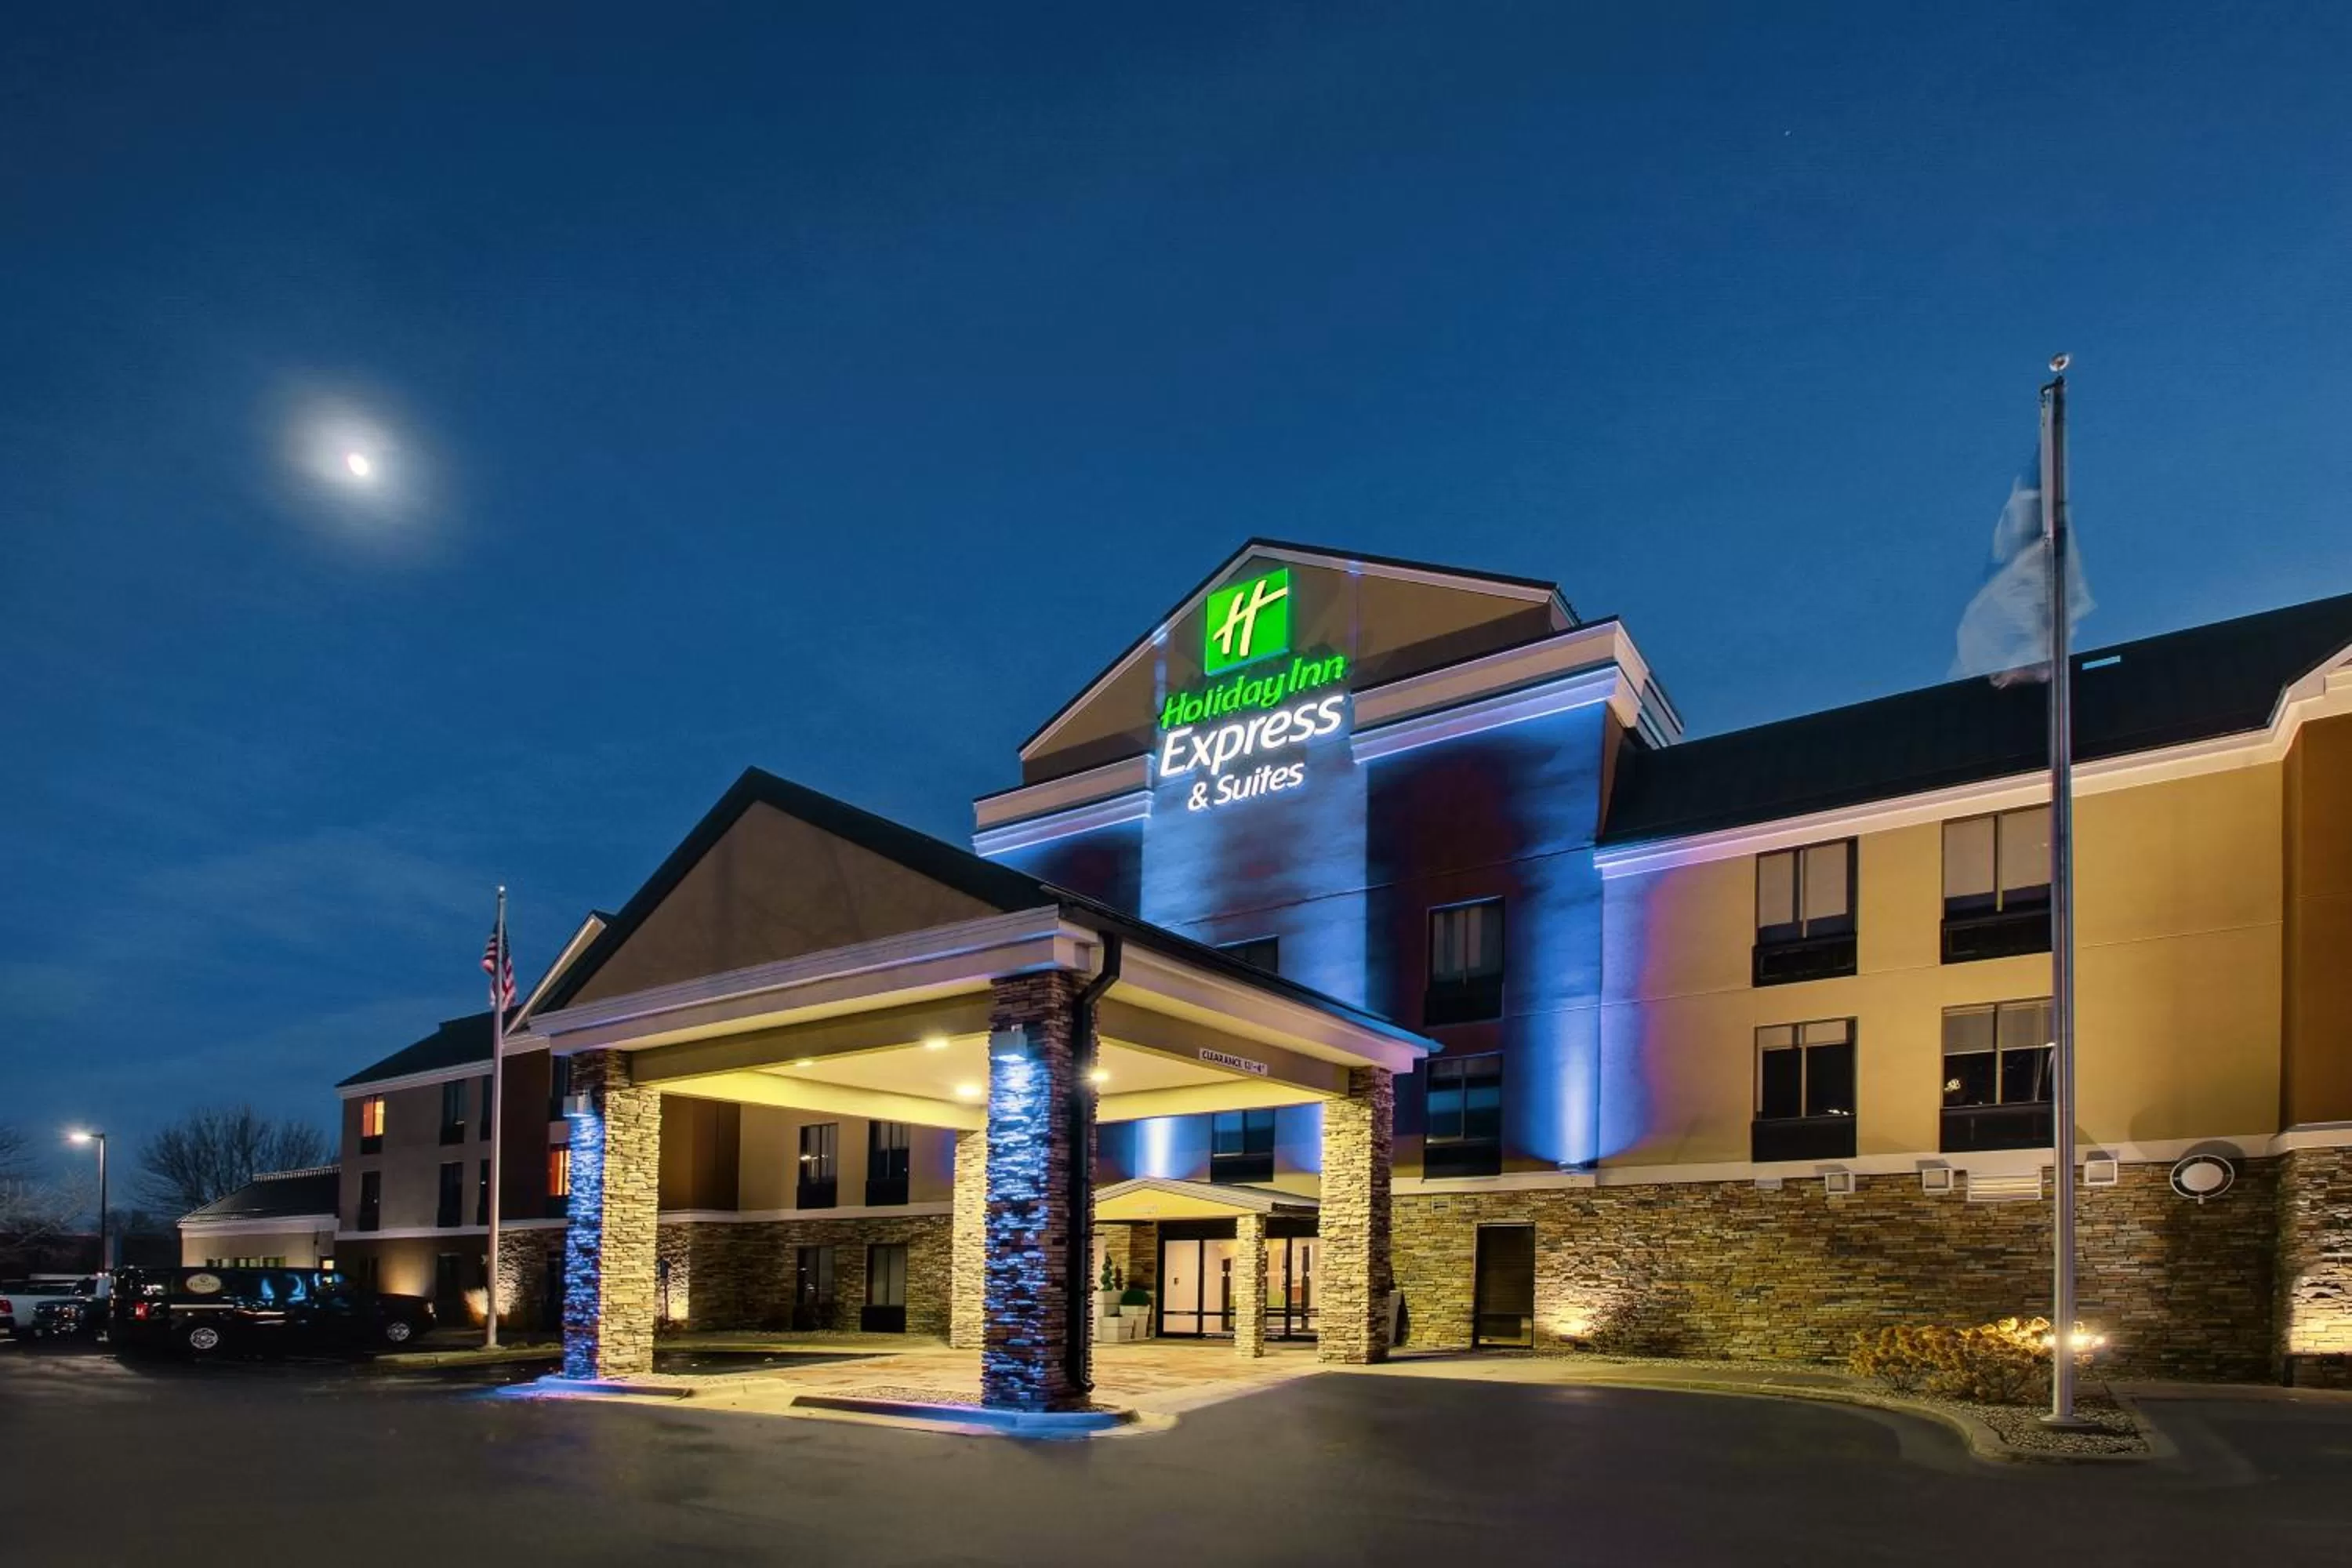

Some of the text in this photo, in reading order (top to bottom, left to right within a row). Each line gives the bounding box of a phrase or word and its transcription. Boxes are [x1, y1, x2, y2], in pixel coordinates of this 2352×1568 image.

[1213, 579, 1288, 656] H
[1160, 656, 1346, 729] Holiday Inn
[1160, 695, 1345, 776] Express
[1187, 763, 1305, 811] & Suites
[1202, 1050, 1242, 1068] CLEARANCE
